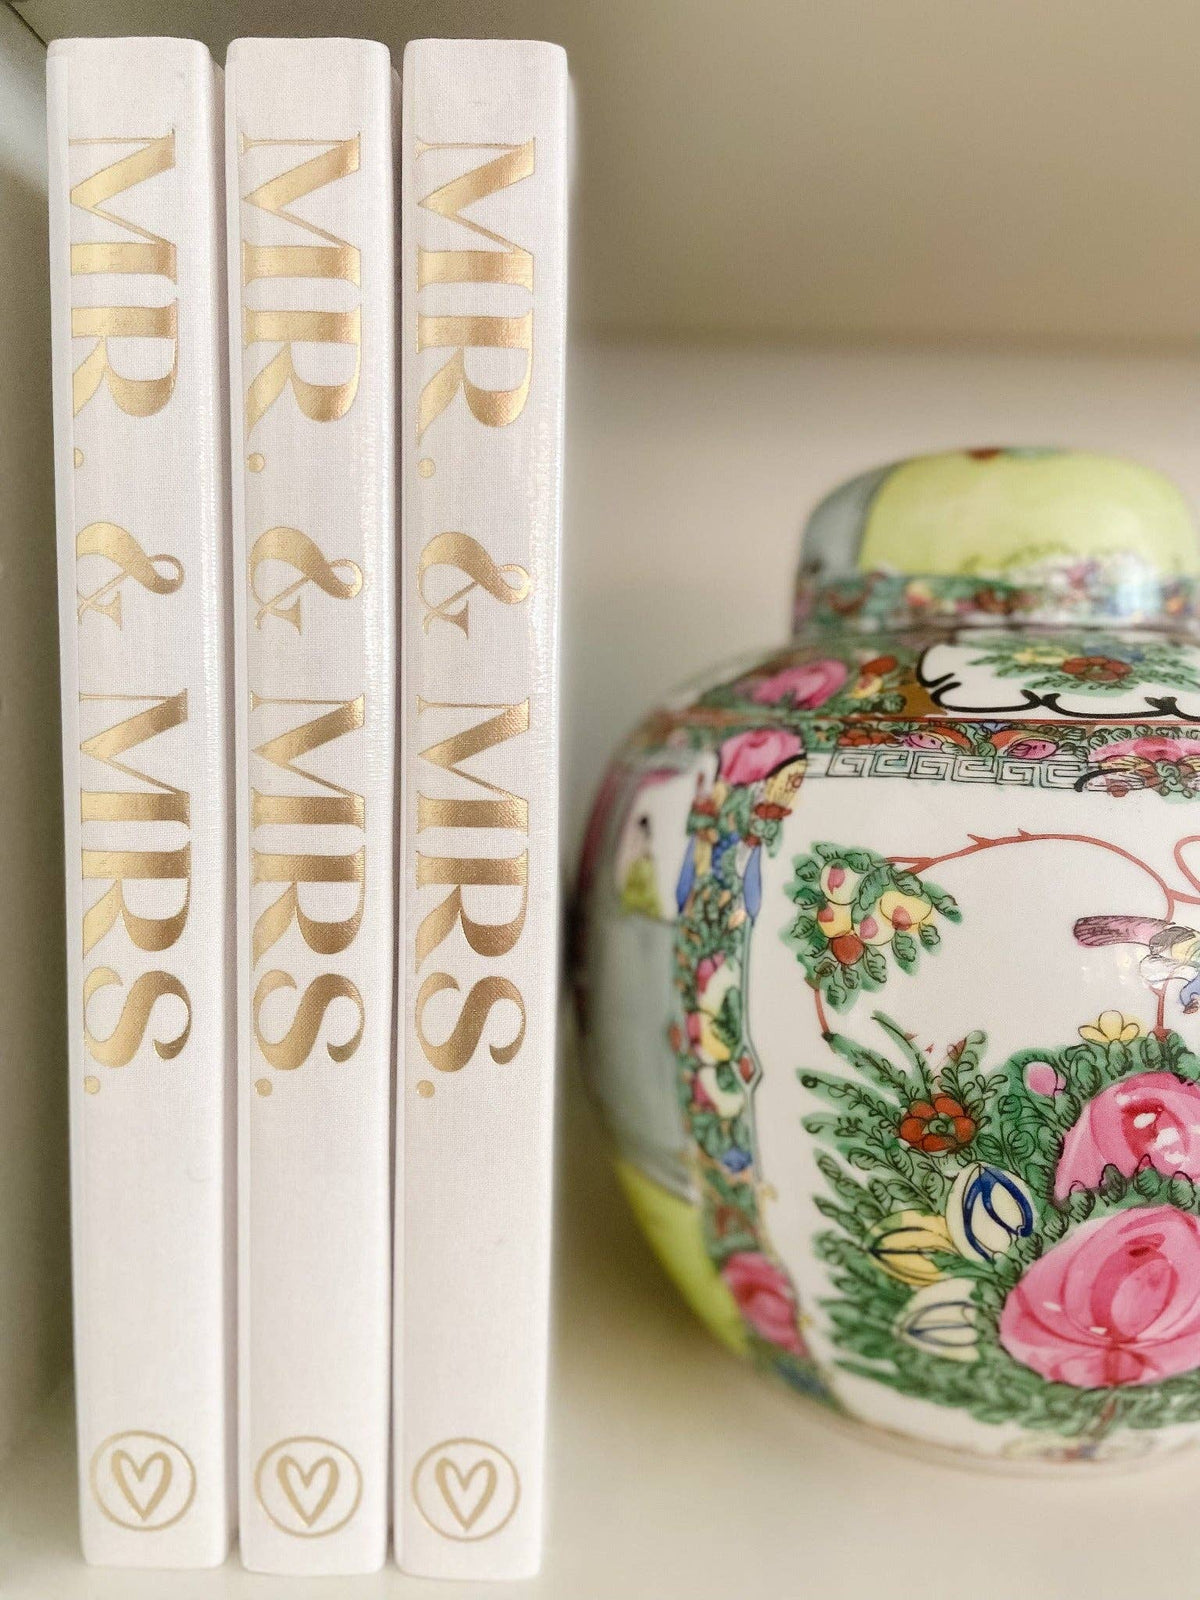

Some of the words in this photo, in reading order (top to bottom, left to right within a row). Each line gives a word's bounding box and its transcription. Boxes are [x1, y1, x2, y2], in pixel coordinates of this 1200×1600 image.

[69, 131, 178, 468] MR.
[238, 133, 362, 473] MR.
[413, 140, 536, 479] MR.
[74, 520, 184, 626] &
[246, 525, 364, 634] &
[415, 530, 532, 636] &
[78, 691, 192, 1095] MRS.
[250, 690, 366, 1098] MRS.
[414, 696, 531, 1099] MRS.
